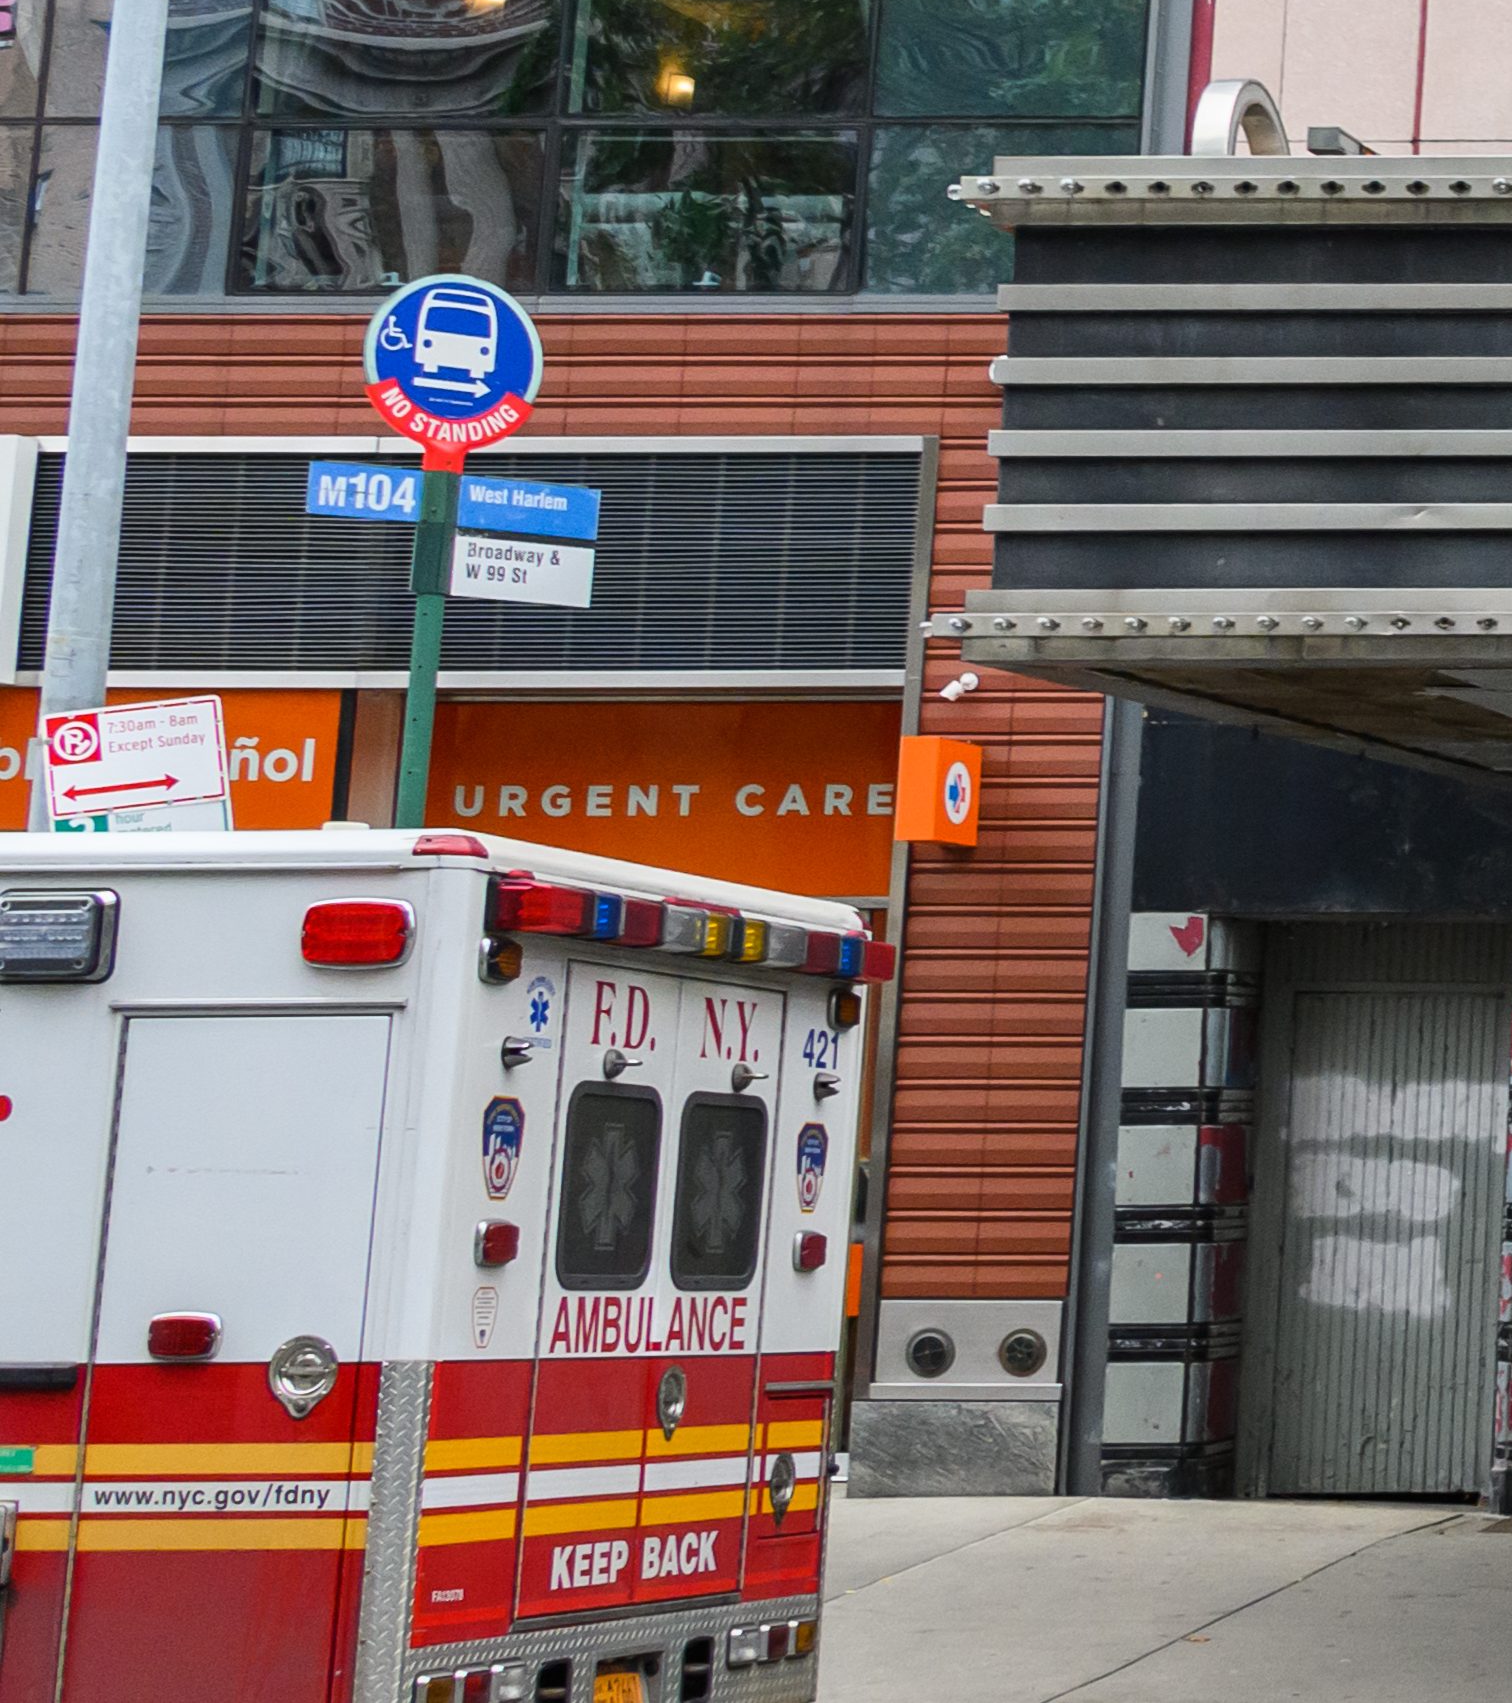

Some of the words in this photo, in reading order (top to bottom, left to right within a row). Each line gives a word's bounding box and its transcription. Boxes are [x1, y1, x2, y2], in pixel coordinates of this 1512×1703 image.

[380, 387, 412, 418] NO
[410, 404, 519, 443] STANDING
[318, 472, 416, 513] M104
[469, 485, 508, 505] West
[512, 488, 568, 512] Harlem
[467, 542, 543, 566] Broadway
[550, 551, 561, 565] &
[466, 564, 480, 580] W
[487, 565, 506, 582] 99
[512, 567, 528, 584] St
[107, 719, 156, 734] 7:30am
[169, 715, 198, 727] 8am
[109, 738, 153, 753] Except
[157, 733, 206, 748] Sunday
[454, 784, 700, 817] URGENT
[735, 783, 895, 817] CARE
[591, 980, 656, 1051] F.D.
[700, 997, 759, 1062] N.Y.
[803, 1028, 840, 1070] 421
[549, 1296, 748, 1354] AMBULANCE
[94, 1484, 330, 1510] www.nyc.gov/fdny
[550, 1540, 630, 1591] KEEP
[641, 1530, 719, 1580] BACK
